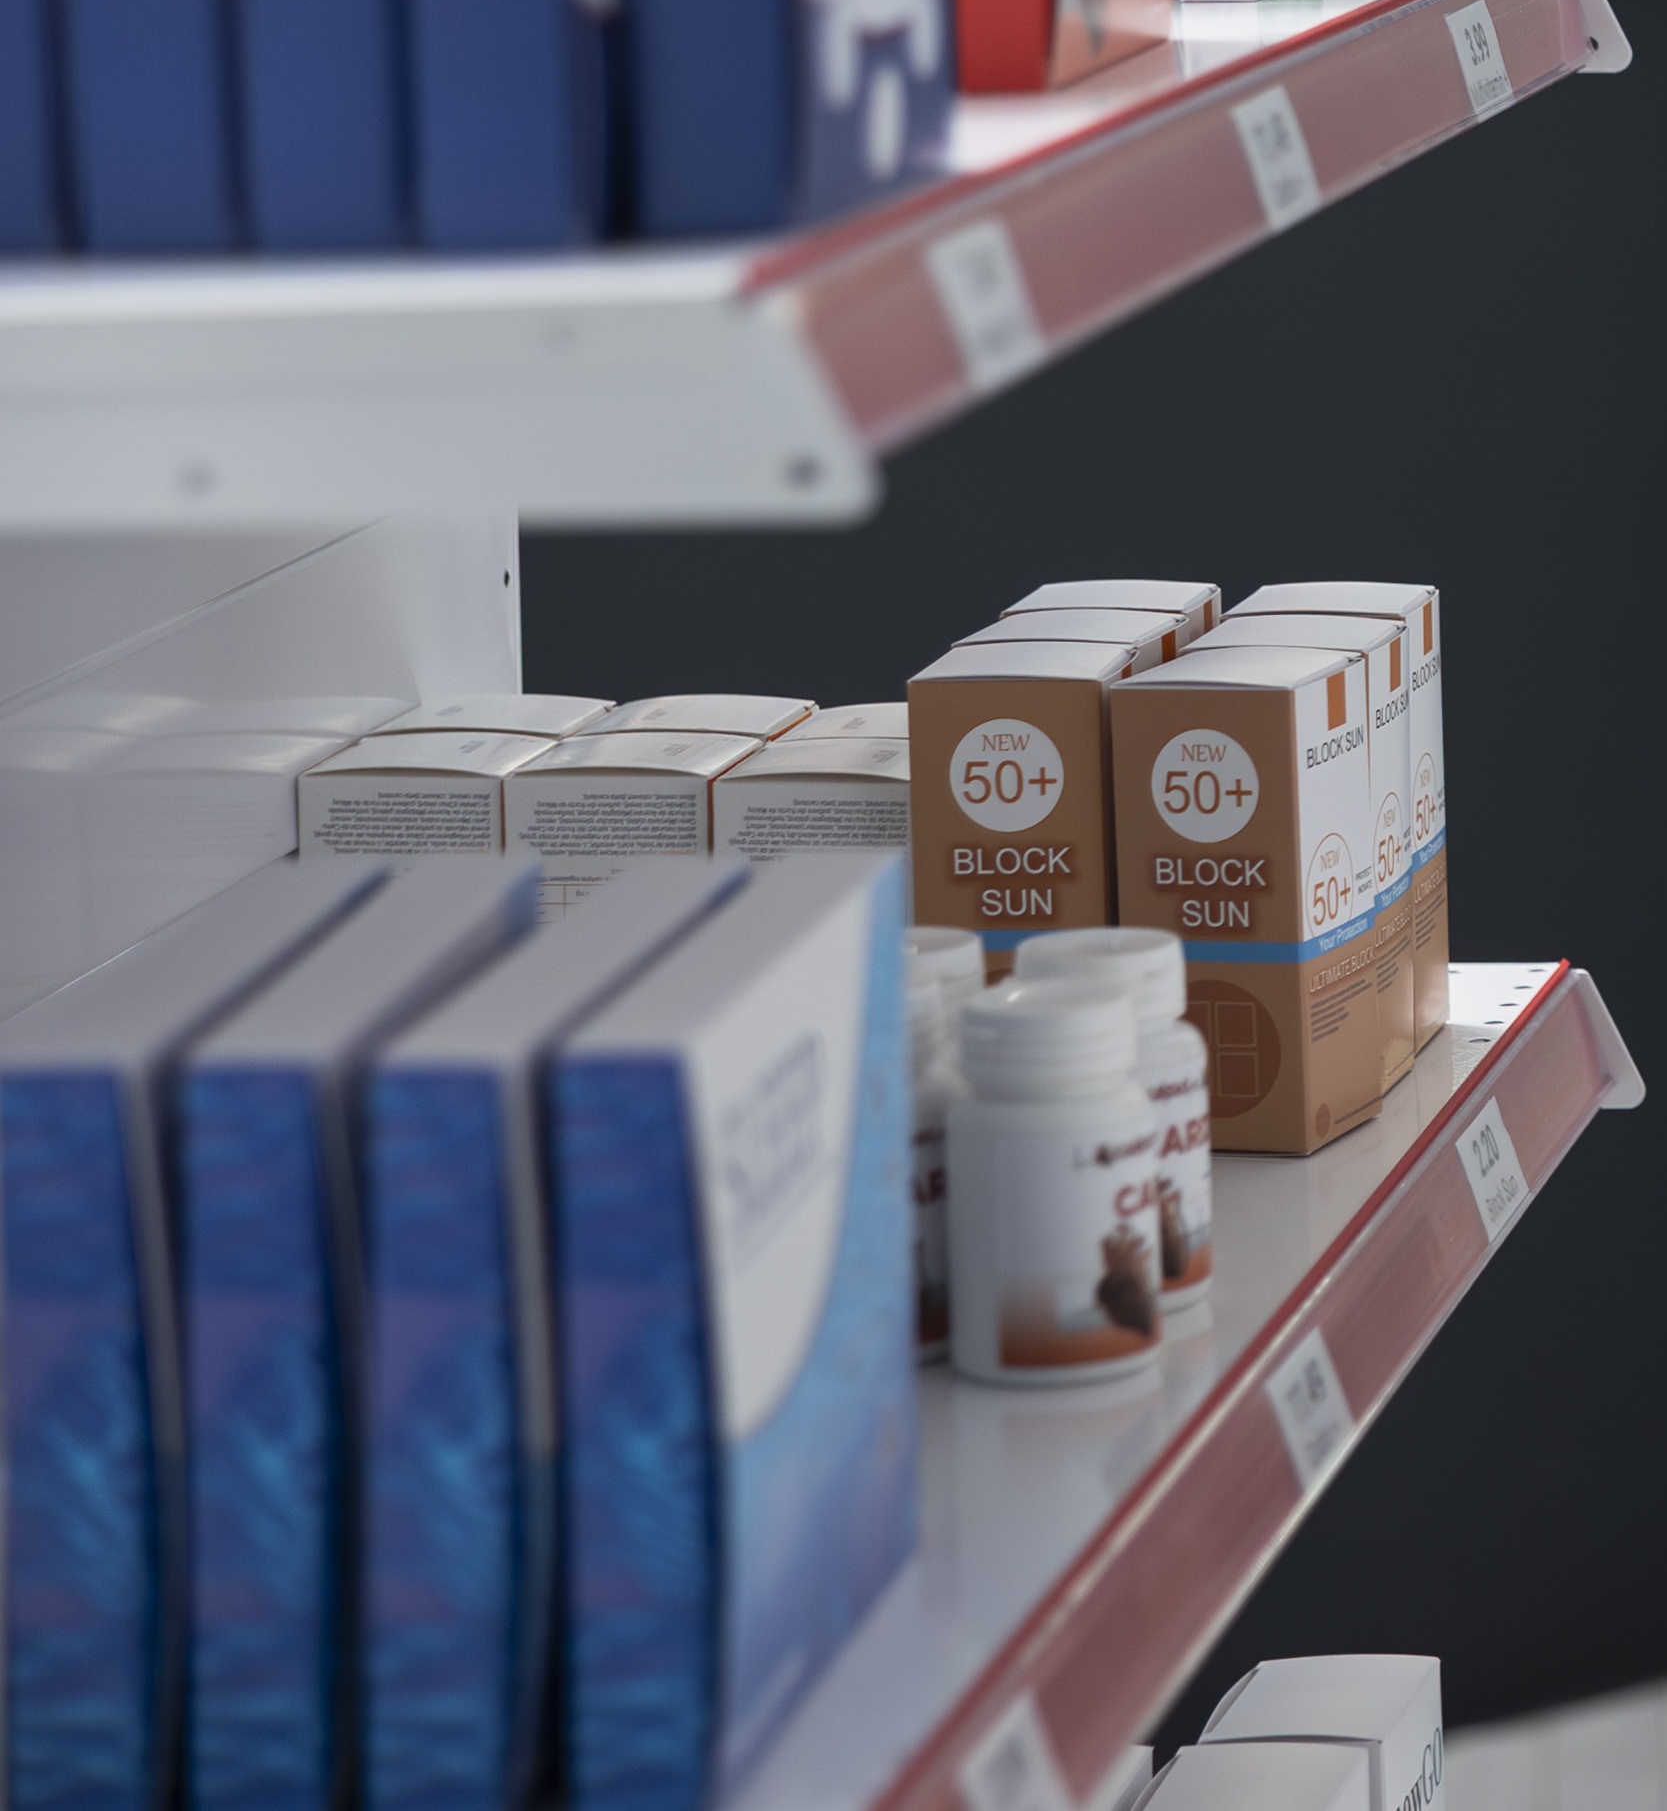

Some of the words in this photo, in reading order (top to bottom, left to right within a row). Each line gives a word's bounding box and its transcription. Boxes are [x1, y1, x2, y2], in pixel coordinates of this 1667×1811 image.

[1464, 22, 1490, 66] 3.99
[982, 733, 1030, 752] NEW
[1181, 744, 1227, 763] NEW
[1306, 734, 1345, 769] BLOCK
[1345, 724, 1364, 752] SUN
[963, 760, 1057, 804] 50+
[1163, 771, 1253, 814] 50+
[1416, 794, 1436, 841] 50+
[953, 847, 1071, 875] BLOCK
[1155, 858, 1266, 886] BLOCK
[1378, 834, 1402, 882] 50+
[981, 889, 1053, 916] SUN
[1182, 900, 1250, 928] SUN
[1313, 876, 1351, 926] 50+
